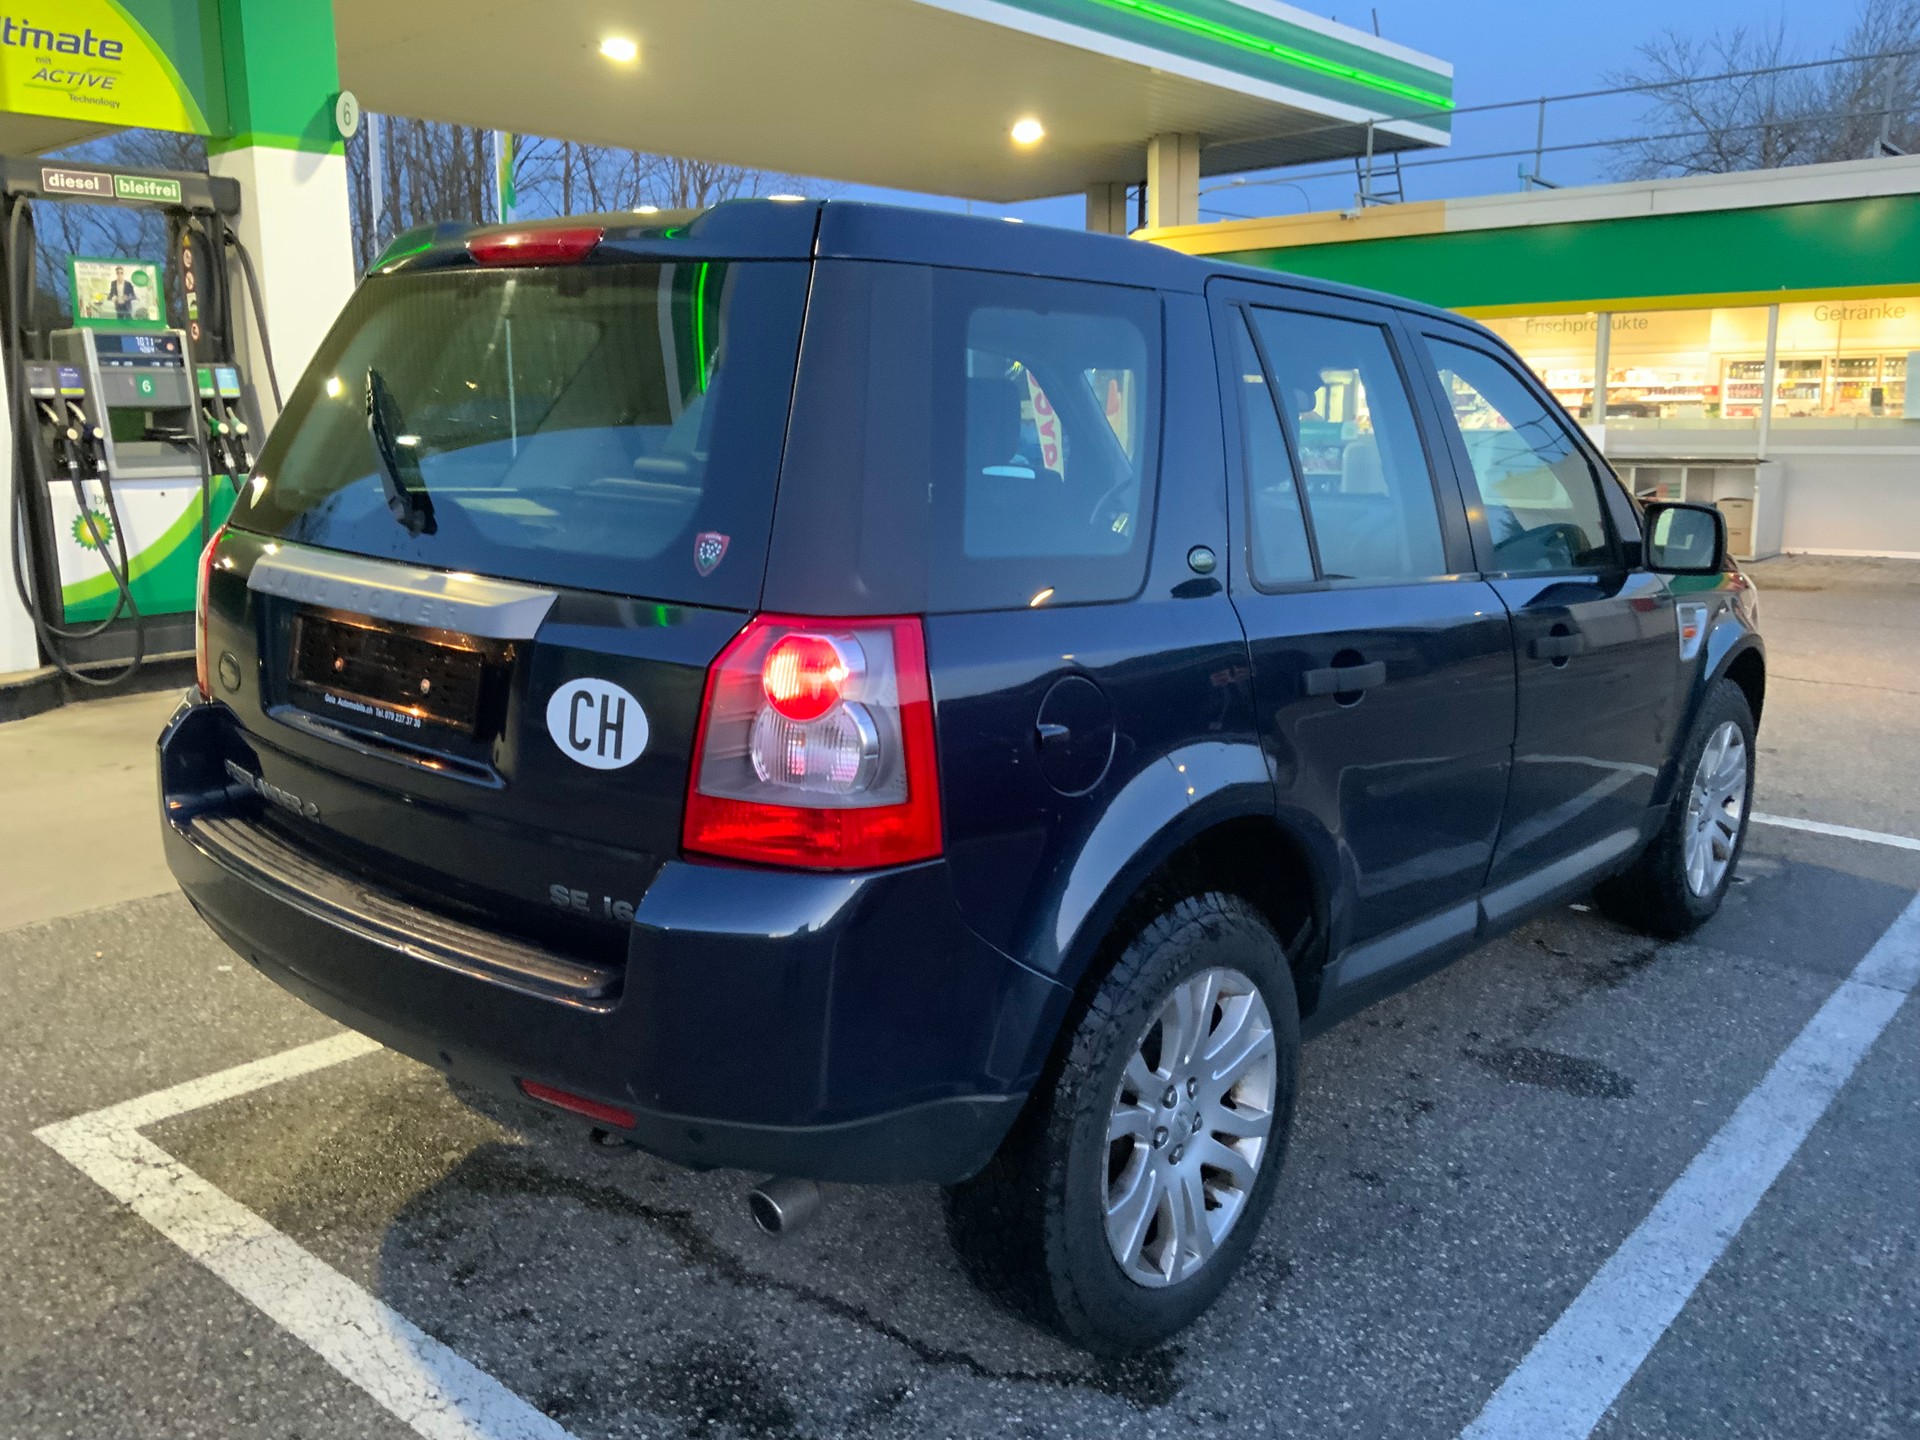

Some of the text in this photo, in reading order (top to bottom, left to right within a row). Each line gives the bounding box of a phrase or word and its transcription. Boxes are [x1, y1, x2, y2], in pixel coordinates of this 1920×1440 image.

[0, 16, 124, 61] timate
[36, 56, 52, 65] mit
[31, 67, 118, 90] ACTIVE
[68, 93, 121, 109] Technology
[343, 101, 352, 127] 6
[48, 173, 100, 191] diesel
[119, 179, 177, 197] bleifrei
[1814, 302, 1906, 322] Getränke
[1525, 315, 1649, 335] Frischproukte
[142, 379, 152, 393] 6
[568, 689, 626, 760] CH
[549, 884, 590, 912] SE
